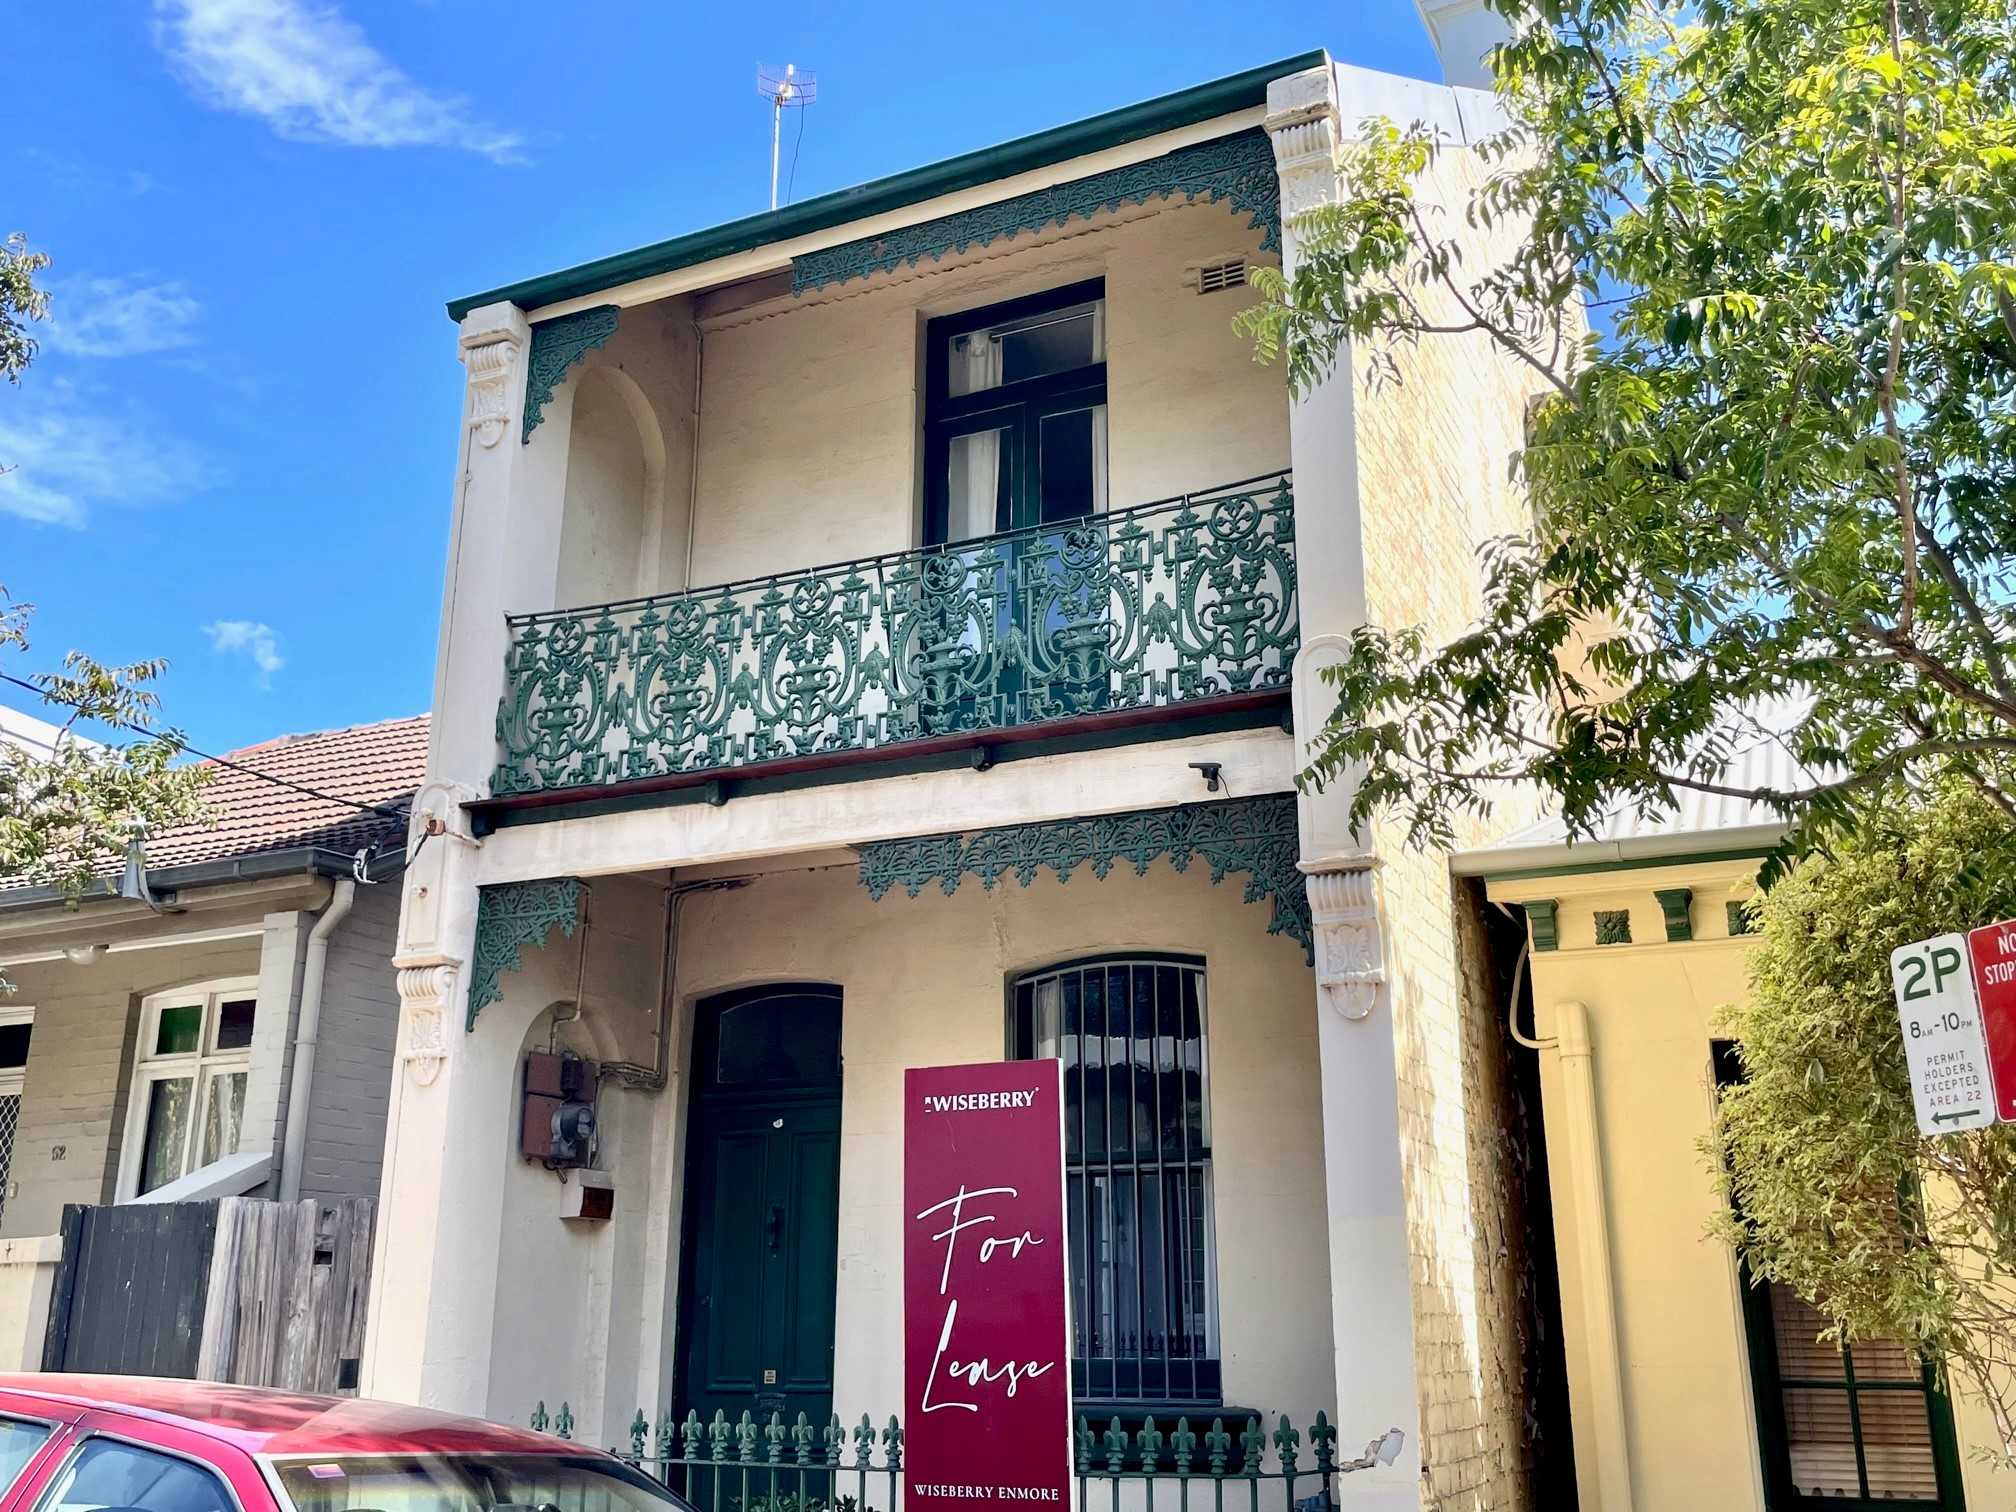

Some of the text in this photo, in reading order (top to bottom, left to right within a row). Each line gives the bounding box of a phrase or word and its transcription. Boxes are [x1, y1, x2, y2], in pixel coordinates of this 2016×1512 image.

[1898, 947, 1961, 1001] 2P
[1984, 960, 2016, 985] STOP
[1926, 1050, 1965, 1066] PERMIT
[1924, 1062, 1974, 1080] HOLDERS
[1923, 1075, 1980, 1094] EXCEPTED
[932, 1090, 1035, 1112] WISEBERRY
[1929, 1090, 1982, 1108] AREA 22
[916, 1184, 1044, 1295] For
[922, 1299, 1055, 1413] Lease
[914, 1484, 1060, 1501] WISEBERRY ENMORE
